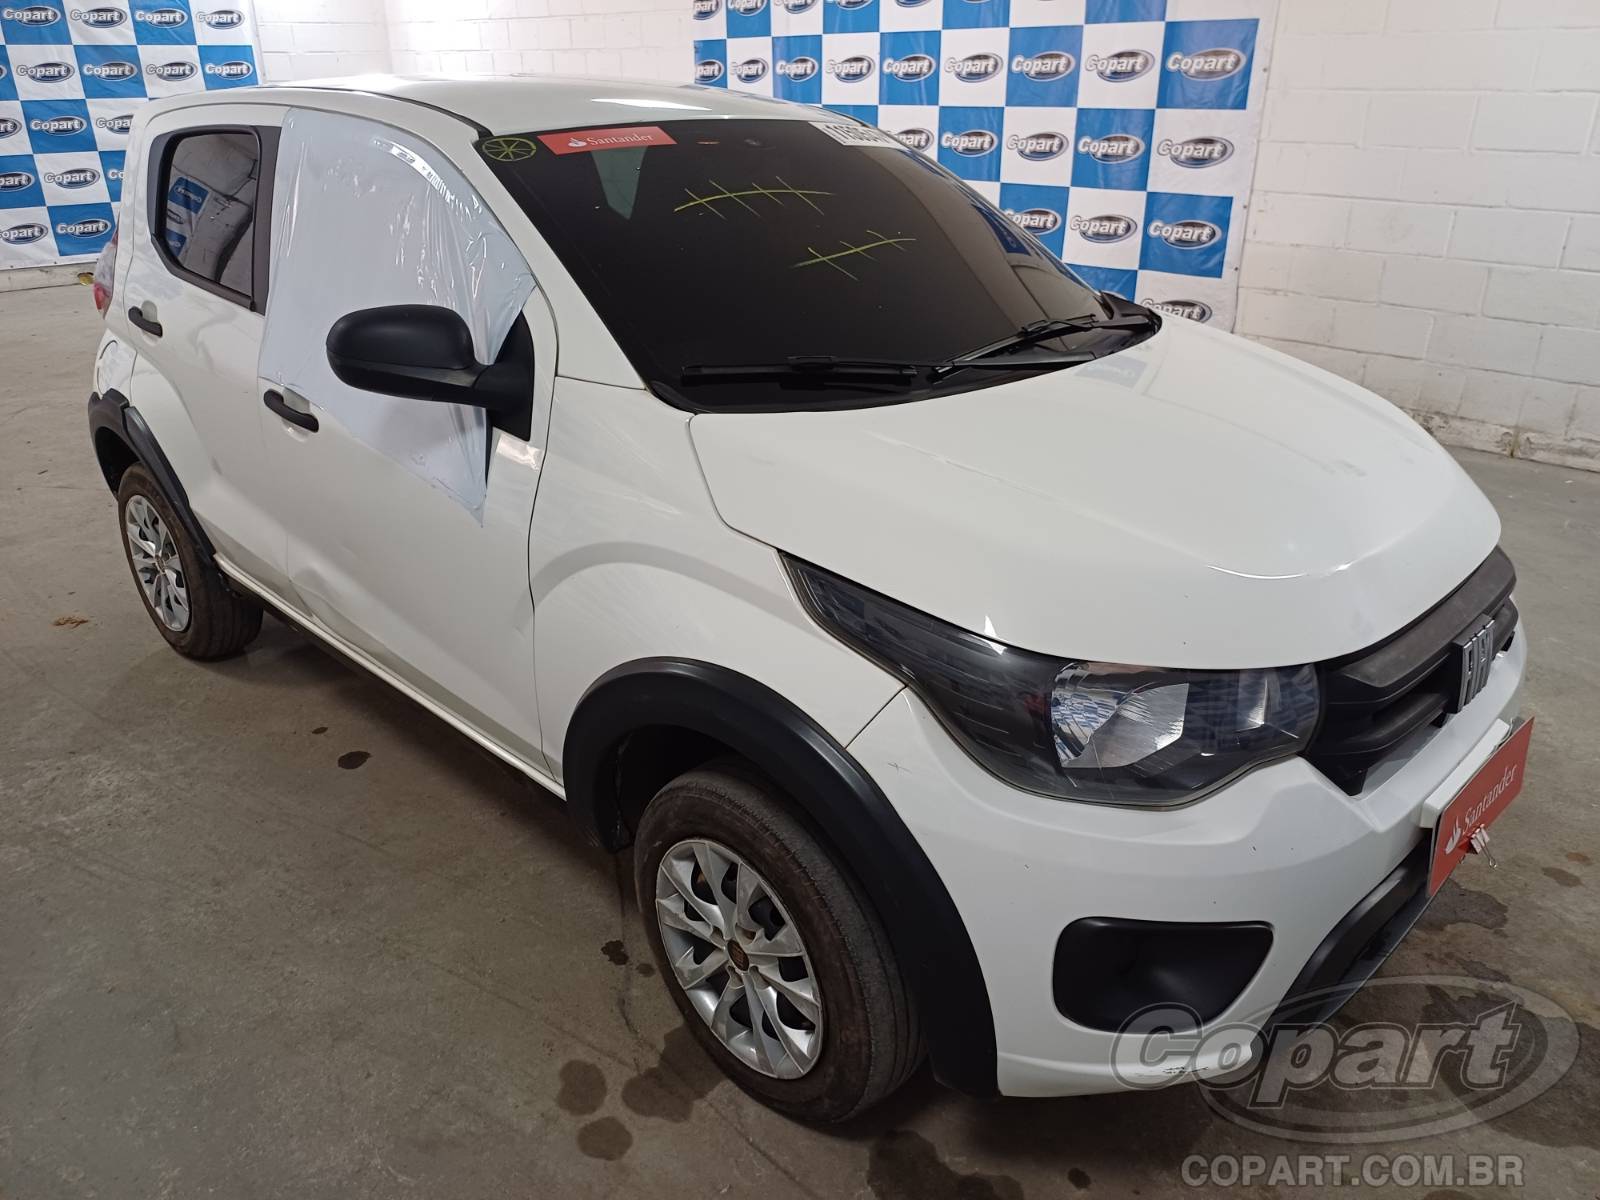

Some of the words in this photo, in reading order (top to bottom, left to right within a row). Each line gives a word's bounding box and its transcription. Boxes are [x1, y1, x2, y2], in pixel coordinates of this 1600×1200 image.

[4, 9, 53, 22] Copart
[72, 10, 122, 22] Copart
[136, 11, 183, 23] Copart
[198, 12, 239, 24] Copart
[17, 63, 69, 79] Copart
[84, 63, 131, 77] Copart
[147, 63, 192, 77] Copart
[206, 63, 248, 77] Copart
[695, 63, 719, 79] part
[731, 61, 763, 75] Copart
[776, 60, 812, 74] Copart
[827, 59, 868, 75] Copart
[883, 57, 931, 75] Copart
[945, 56, 995, 75] Copart
[1011, 54, 1068, 76] Copart
[1086, 53, 1145, 76] Copart
[1167, 52, 1235, 76] Copart
[31, 119, 81, 133] Copart
[97, 119, 131, 131] Copa
[586, 133, 655, 146] Santander
[941, 132, 990, 150] Copart
[1008, 133, 1062, 154] Copart
[1078, 136, 1139, 157] Copart
[1159, 140, 1222, 162] Copart
[0, 175, 27, 188] part
[45, 172, 94, 187] Copart
[0, 226, 41, 240] opart
[57, 222, 104, 236] Copart
[1070, 216, 1127, 236] Copart
[1149, 221, 1211, 243] Copart
[1463, 764, 1517, 834] Santander
